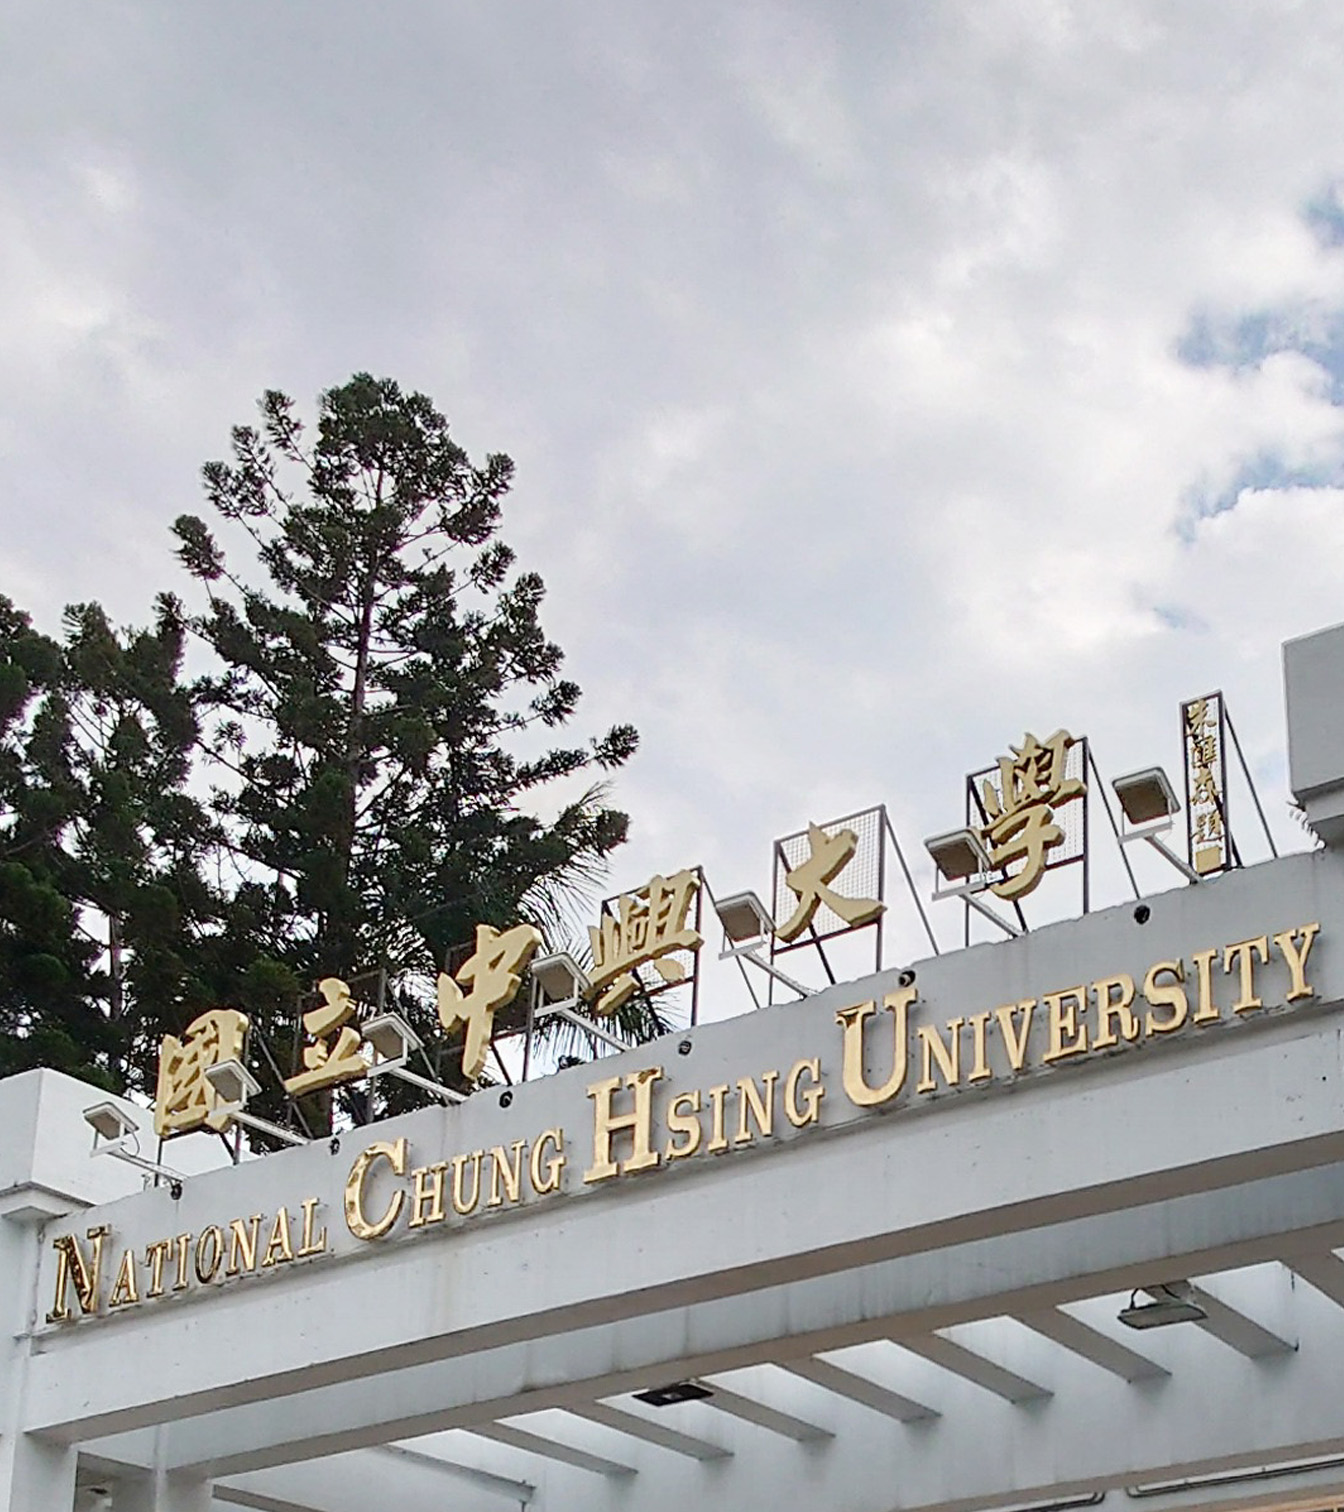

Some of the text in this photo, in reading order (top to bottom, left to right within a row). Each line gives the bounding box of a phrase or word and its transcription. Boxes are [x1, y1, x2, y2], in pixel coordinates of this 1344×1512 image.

[46, 921, 1322, 1323] NATIONAL CHUNG HSING UNIVERSITY
